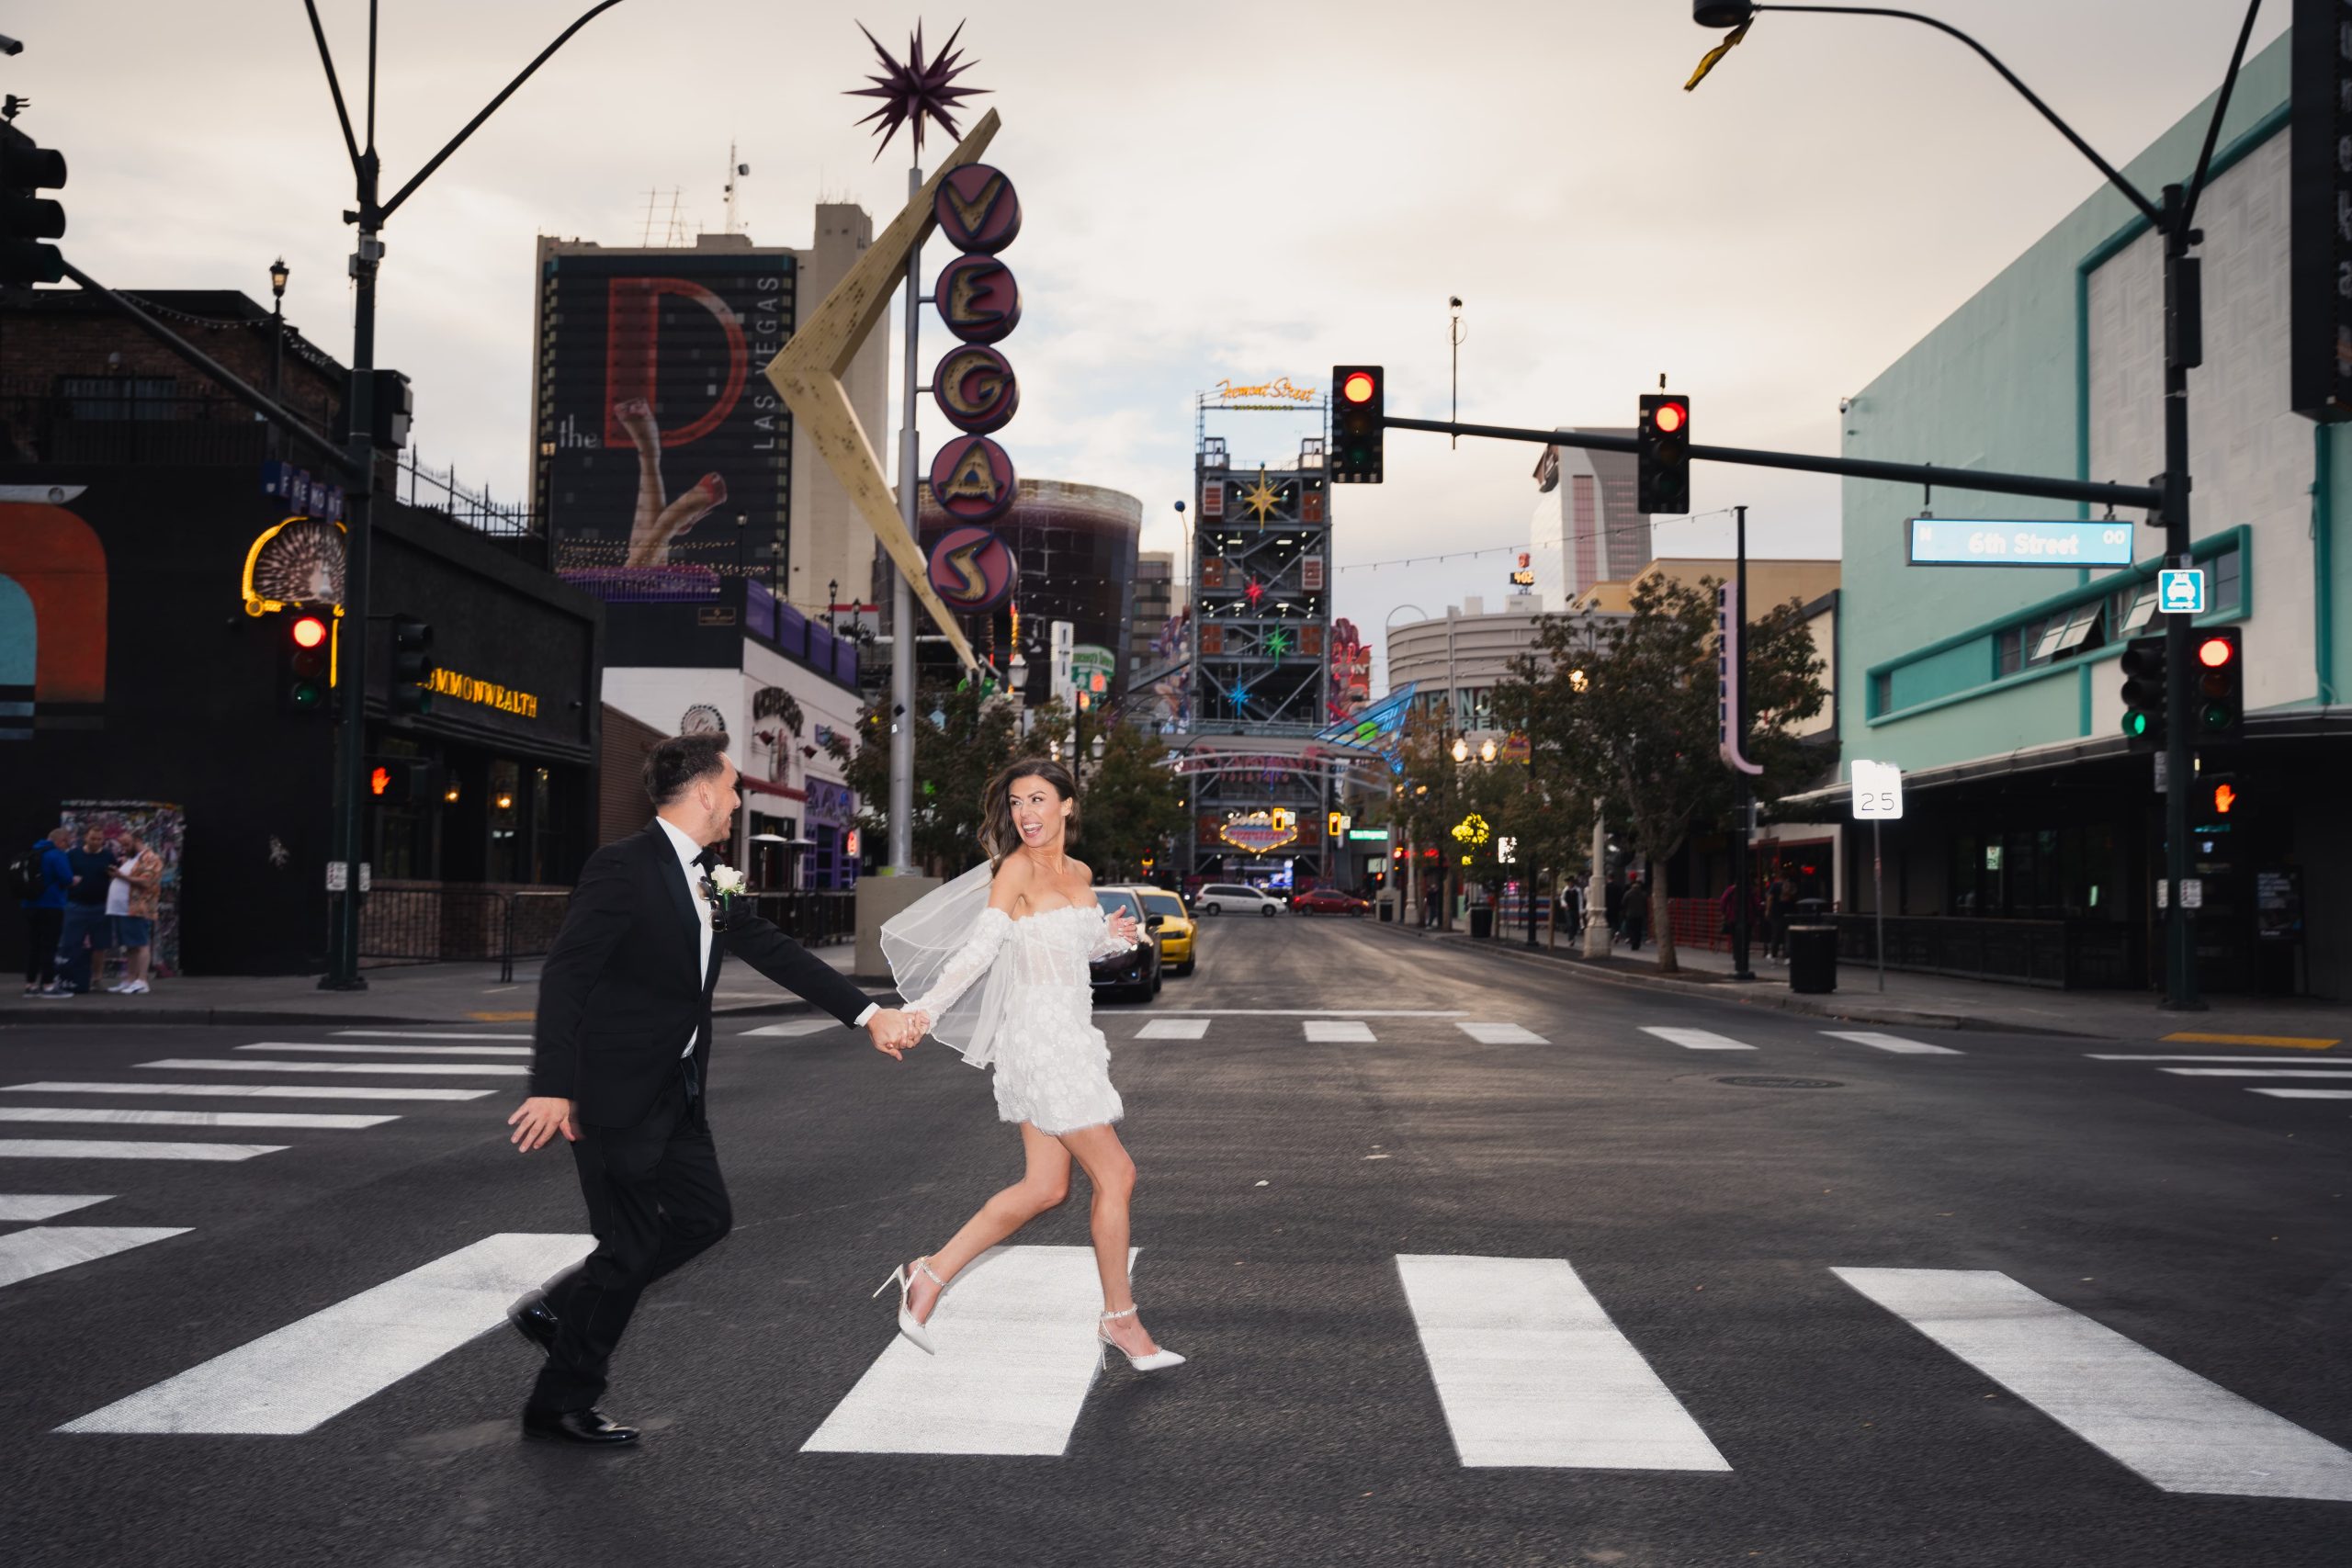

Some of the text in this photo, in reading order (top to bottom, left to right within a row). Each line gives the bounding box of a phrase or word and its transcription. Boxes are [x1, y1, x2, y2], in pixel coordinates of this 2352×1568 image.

[605, 277, 748, 447] D
[753, 277, 779, 449] LAS VEGAS
[937, 169, 1012, 602] VEGAS
[1216, 377, 1316, 408] Fremont Street
[559, 413, 597, 448] the
[1968, 532, 2007, 555] 6th
[2014, 533, 2079, 556] Street
[2102, 529, 2126, 545] 00
[1861, 792, 1894, 811] 25
